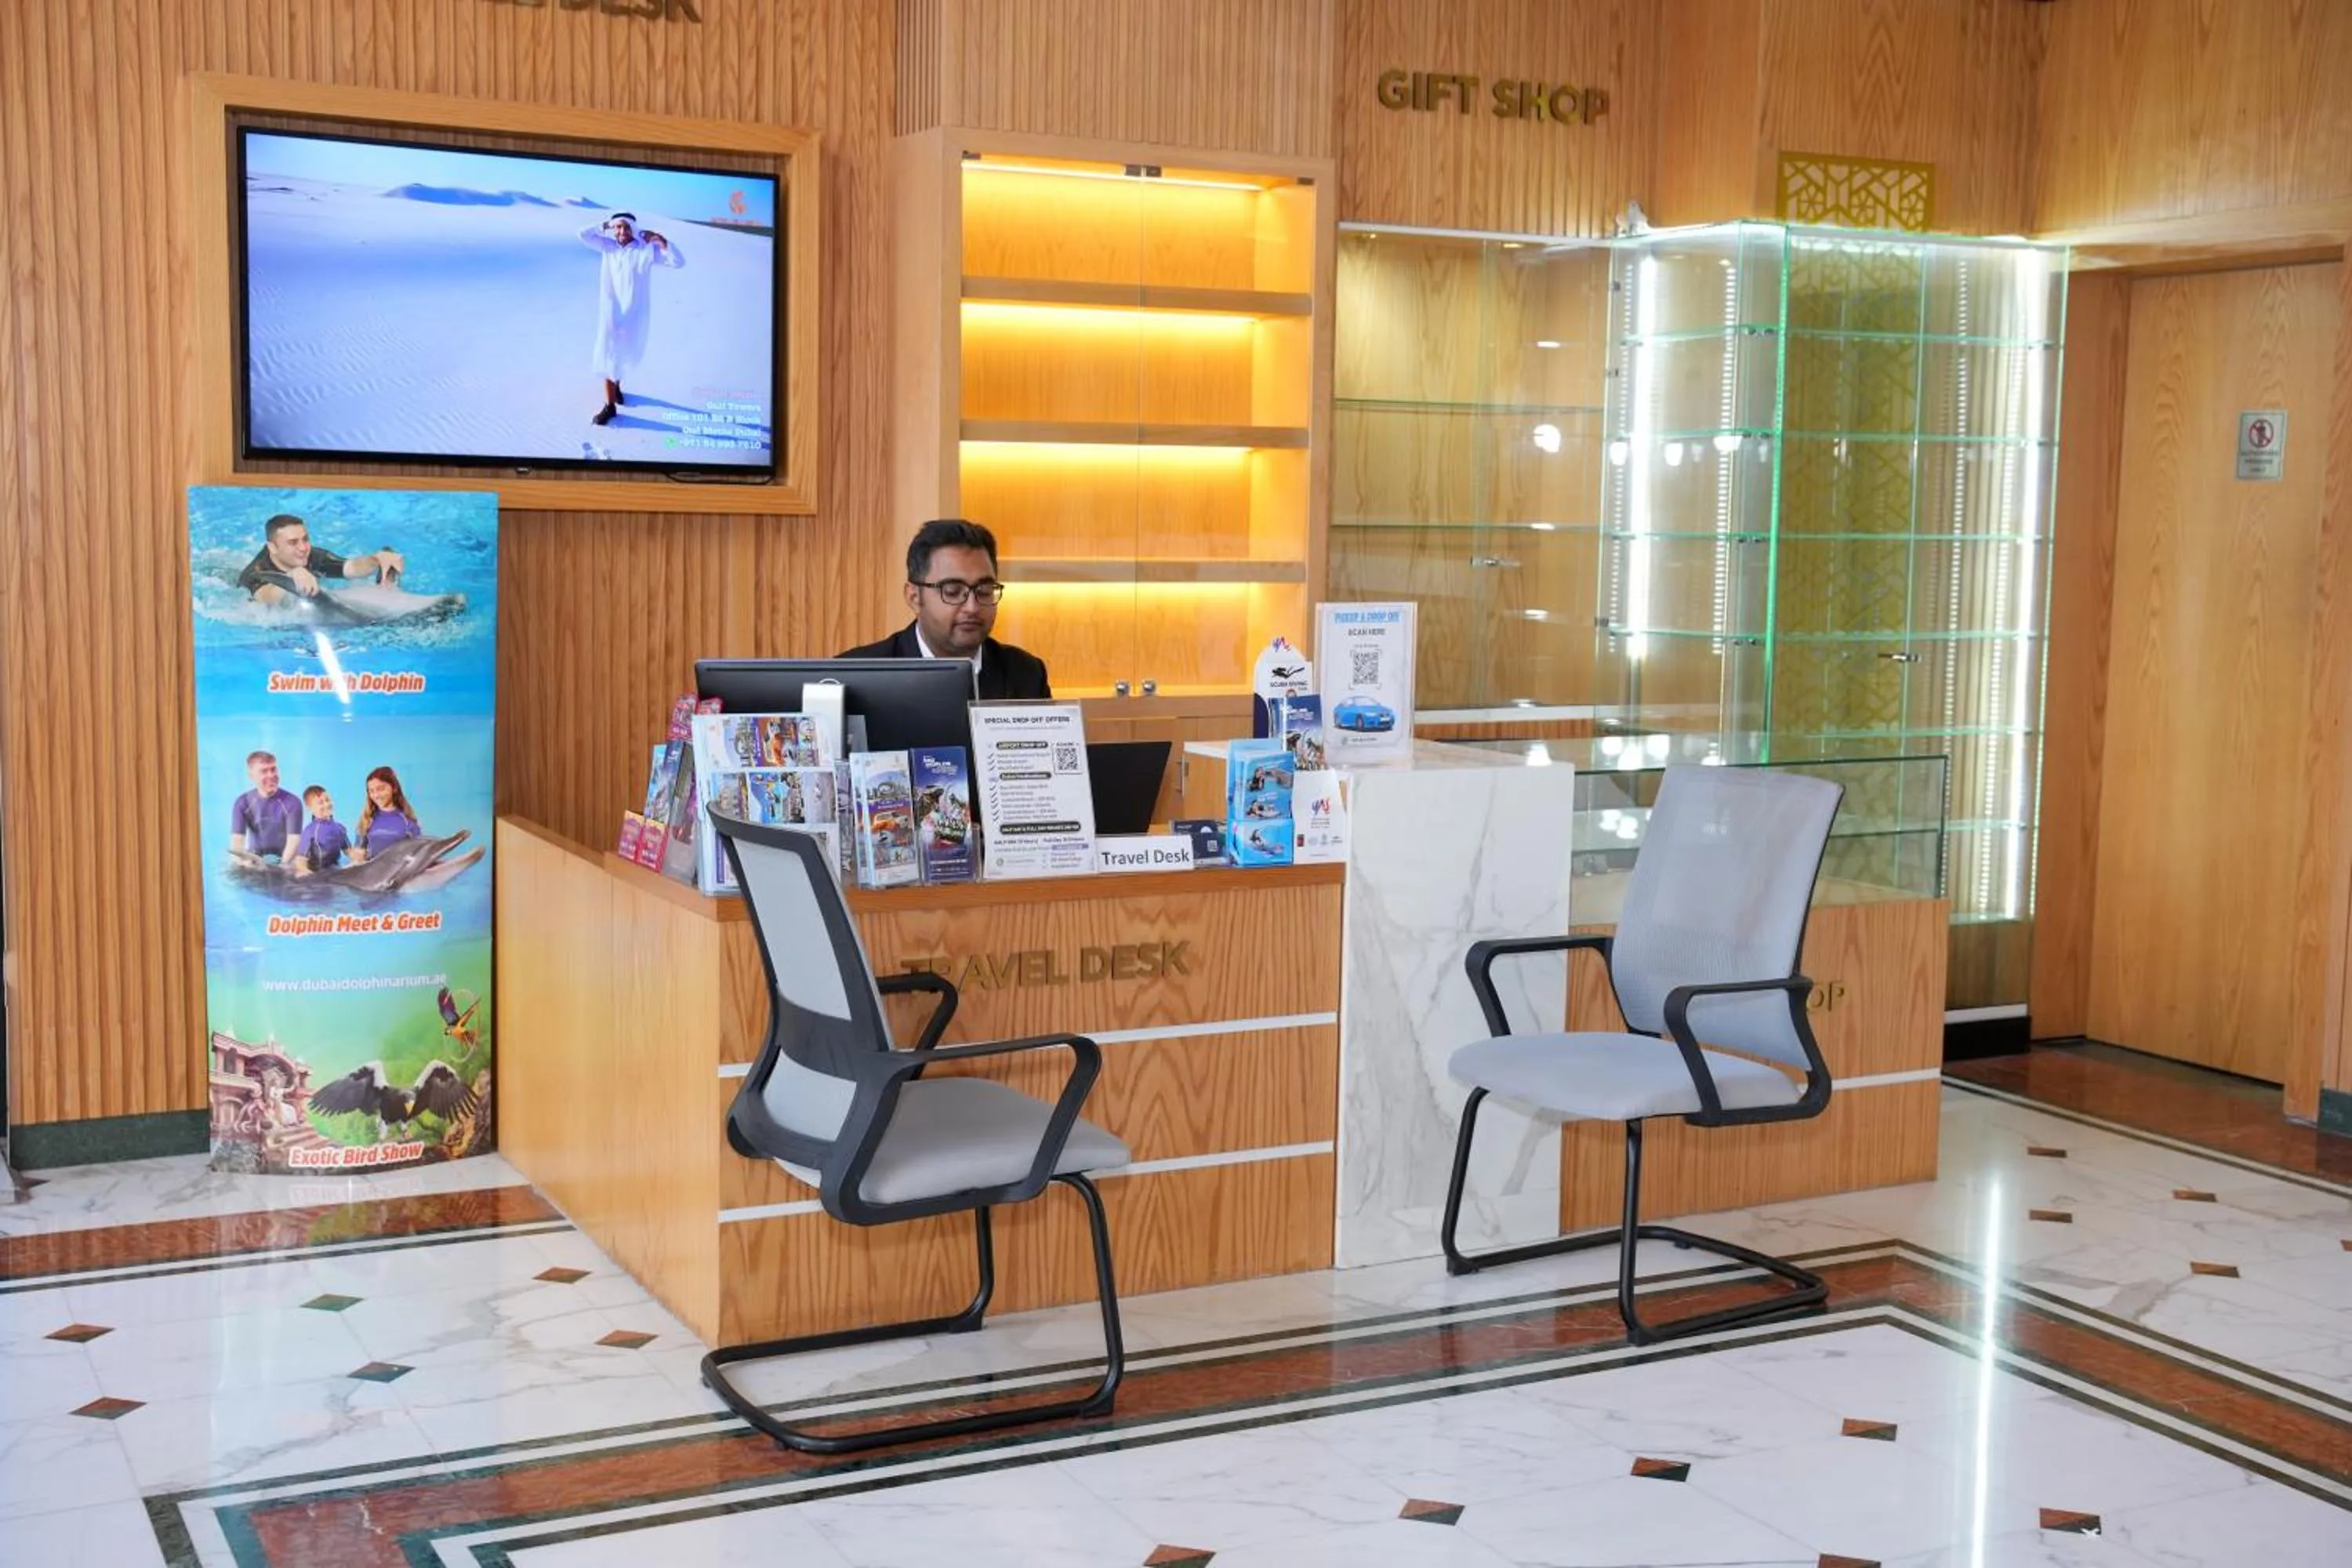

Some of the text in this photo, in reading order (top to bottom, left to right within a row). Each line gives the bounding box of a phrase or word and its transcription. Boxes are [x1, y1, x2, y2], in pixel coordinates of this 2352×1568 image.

[1377, 69, 1610, 125] GIFT SHOP
[270, 673, 424, 692] Swim wh Dolphin
[1101, 849, 1149, 866] Travel
[1153, 848, 1189, 863] Desk
[269, 913, 440, 935] Dolphin Meet & Greet
[1080, 940, 1191, 984] DESK
[263, 974, 447, 993] www.dubaidolphinarium.ae
[290, 1143, 422, 1165] Exotic Bird Show
